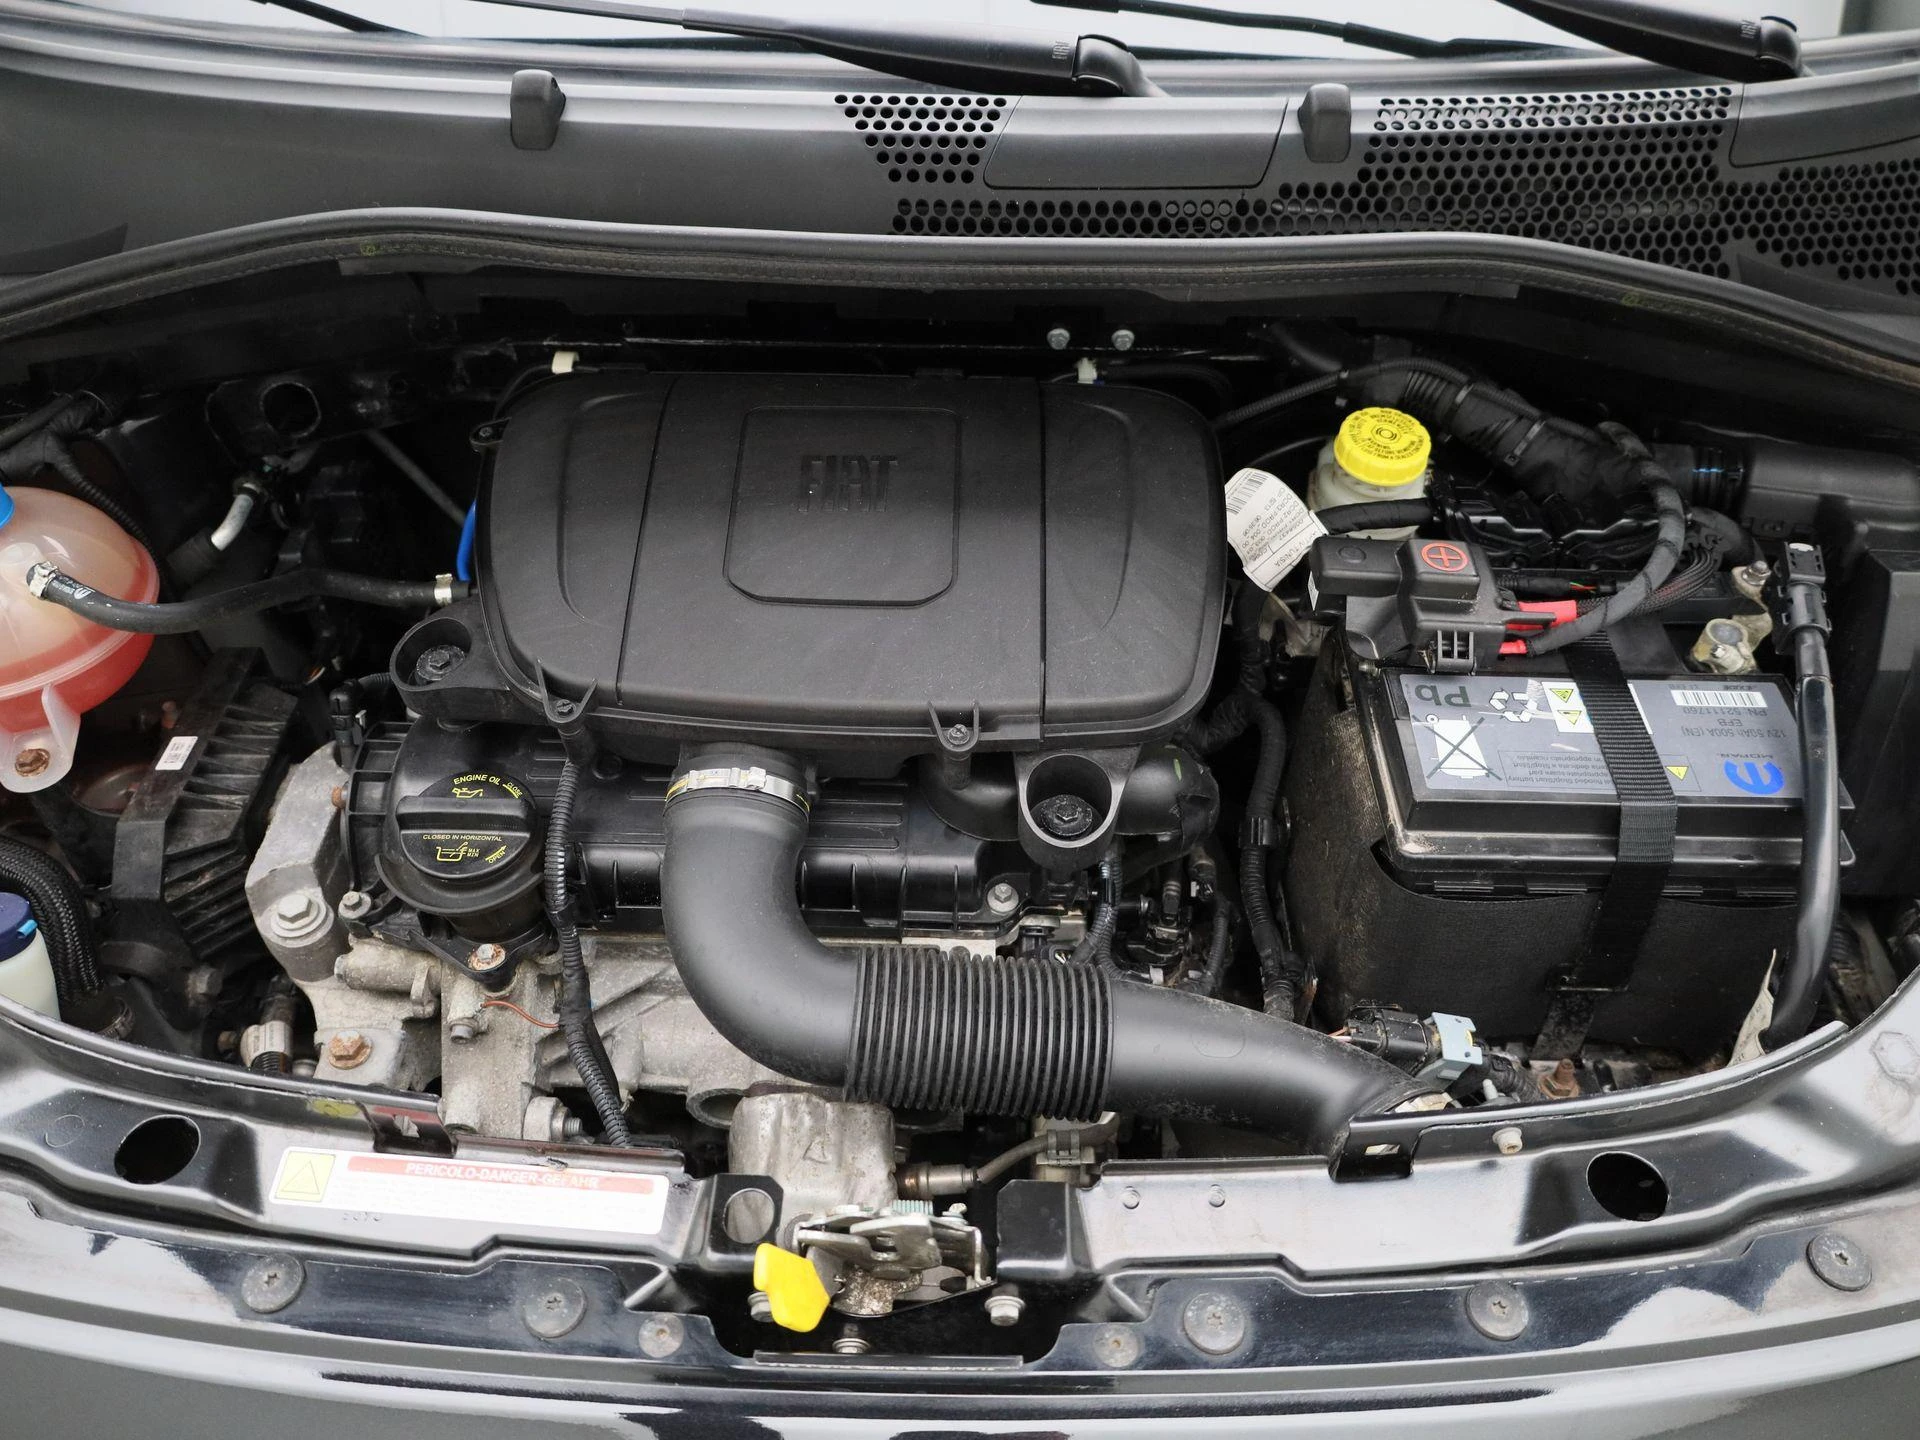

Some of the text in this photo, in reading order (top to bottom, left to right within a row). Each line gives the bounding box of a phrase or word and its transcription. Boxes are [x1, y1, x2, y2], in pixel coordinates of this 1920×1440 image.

[798, 455, 898, 513] FIAT
[1414, 684, 1472, 708] Pb
[1717, 718, 1743, 727] EFB
[1680, 726, 1787, 738] 12V 50Ah 500A (EN)
[453, 774, 501, 786] ENGINE OIL
[507, 782, 523, 797] CLOSE
[489, 850, 506, 864] OPEN
